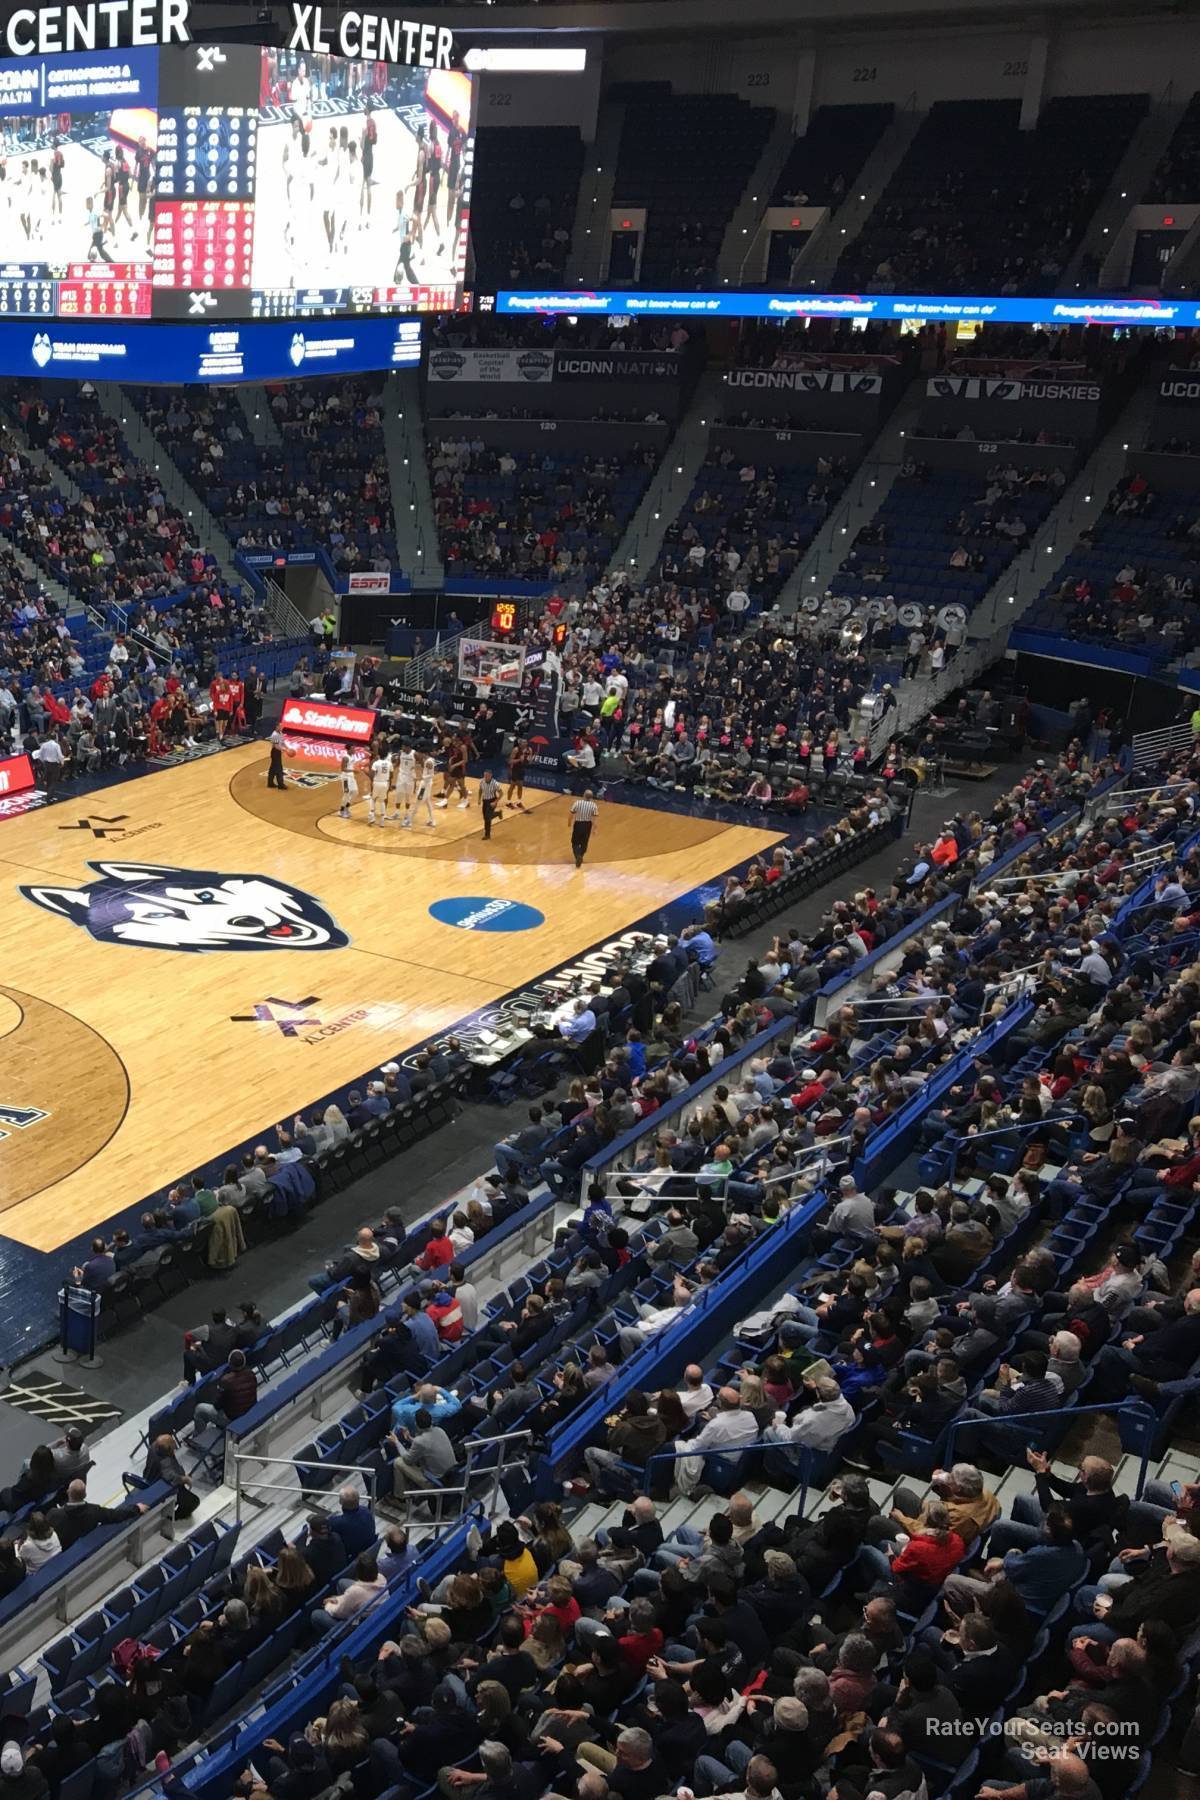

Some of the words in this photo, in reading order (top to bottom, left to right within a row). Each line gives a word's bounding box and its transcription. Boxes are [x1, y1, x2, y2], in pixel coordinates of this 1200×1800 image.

[7, 0, 191, 56] CENTER
[290, 3, 330, 54] XL
[340, 11, 454, 69] CENTER
[747, 72, 770, 86] 223
[853, 68, 877, 82] 224
[489, 94, 511, 106] 222
[1, 290, 7, 301] 3
[14, 290, 22, 301] 0
[29, 290, 37, 301] 0
[42, 290, 50, 301] 0
[479, 296, 494, 304] 7:15
[0, 301, 8, 312] 0
[29, 302, 36, 312] 2
[42, 301, 50, 312] 0
[84, 302, 93, 313] 0
[100, 302, 108, 313] 0
[114, 302, 123, 313] 0
[189, 292, 218, 314] XL
[627, 299, 648, 308] What
[894, 304, 916, 313] What
[472, 351, 510, 360] Basketball
[558, 360, 614, 374] UCONN
[728, 371, 794, 388] UCONN
[1021, 383, 1101, 400] HUSKIES
[539, 422, 556, 431] 120
[776, 433, 792, 442] 121
[978, 444, 997, 454] 122
[351, 578, 388, 589] ESPN
[496, 602, 515, 614] 12:55
[500, 613, 513, 629] 10
[457, 899, 512, 931] genius3D
[301, 1032, 325, 1045] XL
[319, 1010, 369, 1036] CENTER
